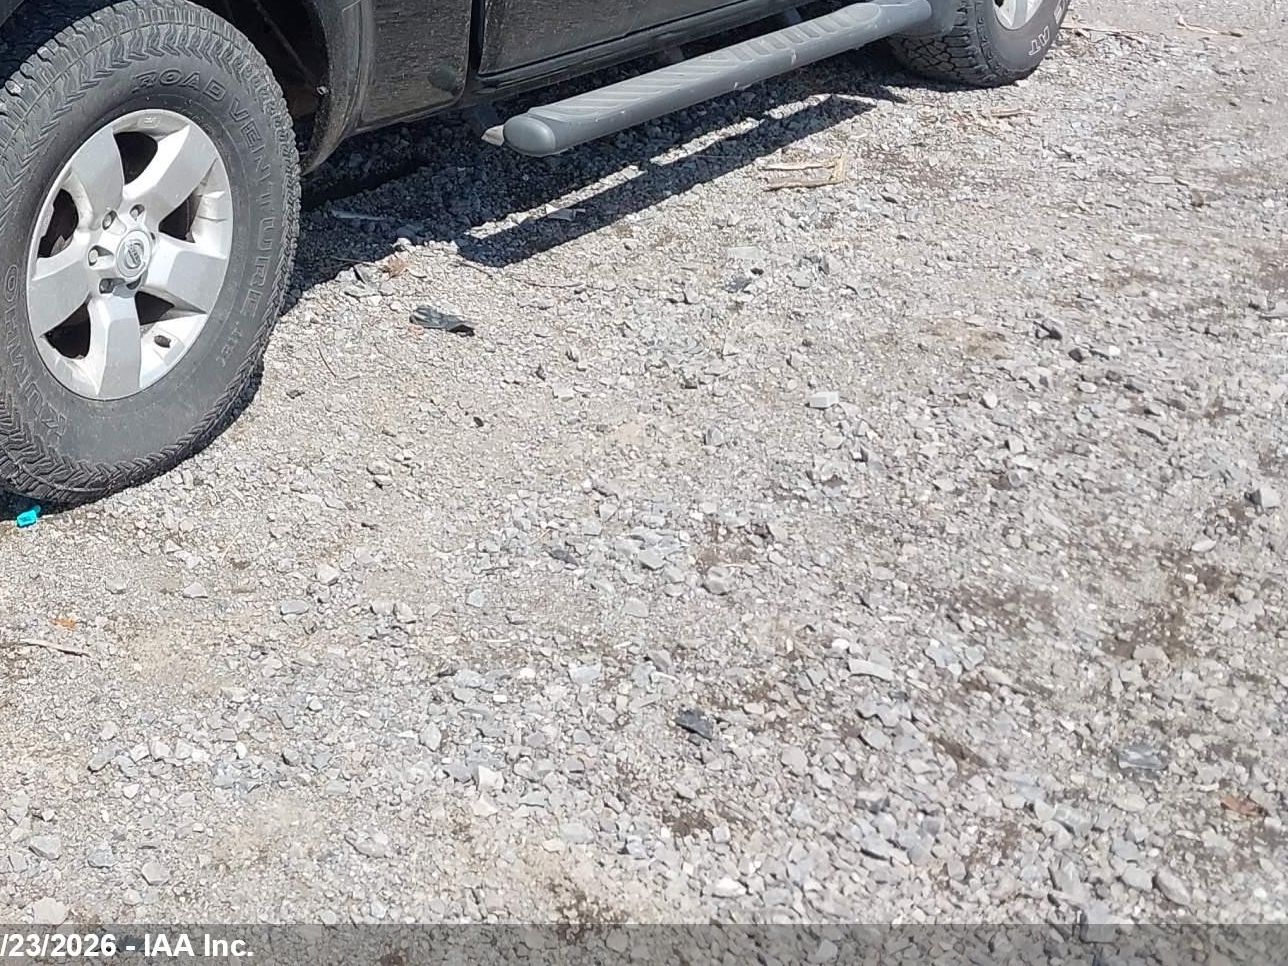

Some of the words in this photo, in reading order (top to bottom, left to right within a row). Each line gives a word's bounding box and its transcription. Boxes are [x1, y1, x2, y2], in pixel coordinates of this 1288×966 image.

[131, 68, 226, 102] ROAD
[228, 98, 277, 317] VENTURE
[4, 264, 67, 439] KUMHO
